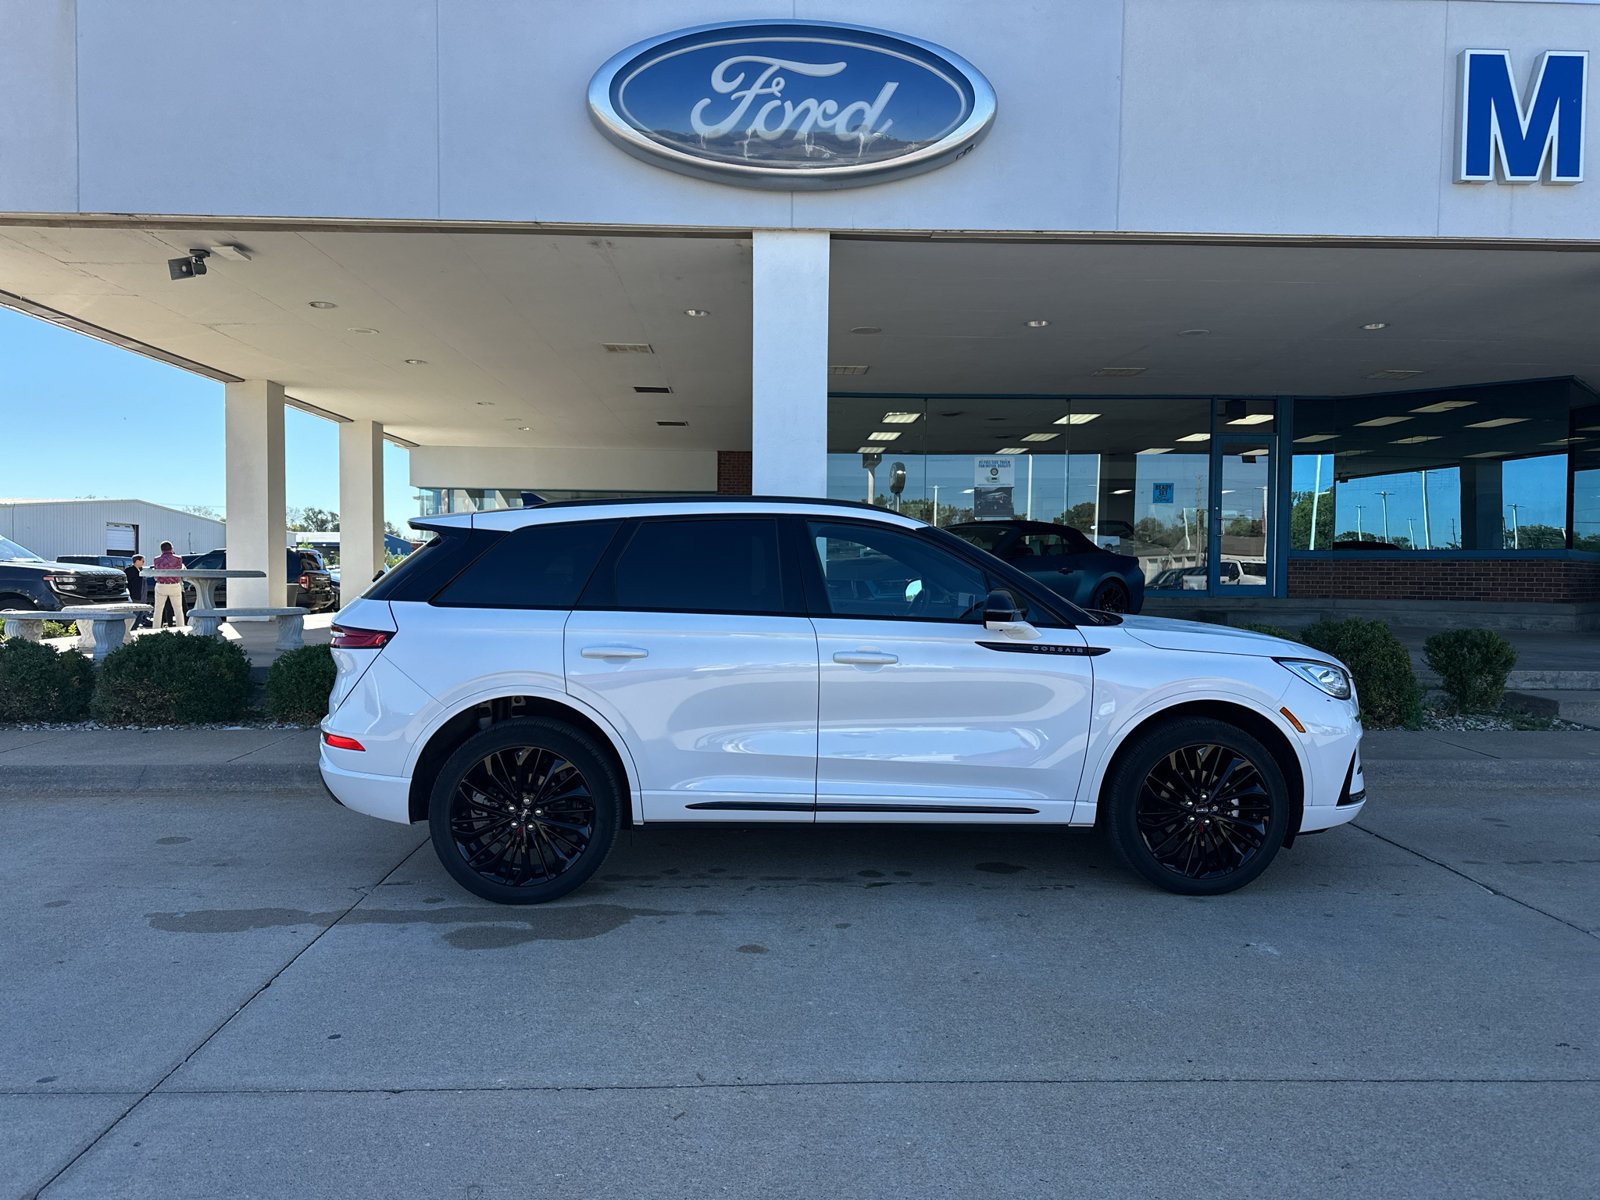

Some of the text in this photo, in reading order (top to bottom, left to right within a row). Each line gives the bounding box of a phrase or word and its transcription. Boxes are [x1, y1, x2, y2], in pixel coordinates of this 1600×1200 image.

[690, 55, 899, 142] Ford
[1460, 49, 1589, 182] M
[1032, 645, 1083, 653] CORSAIR
